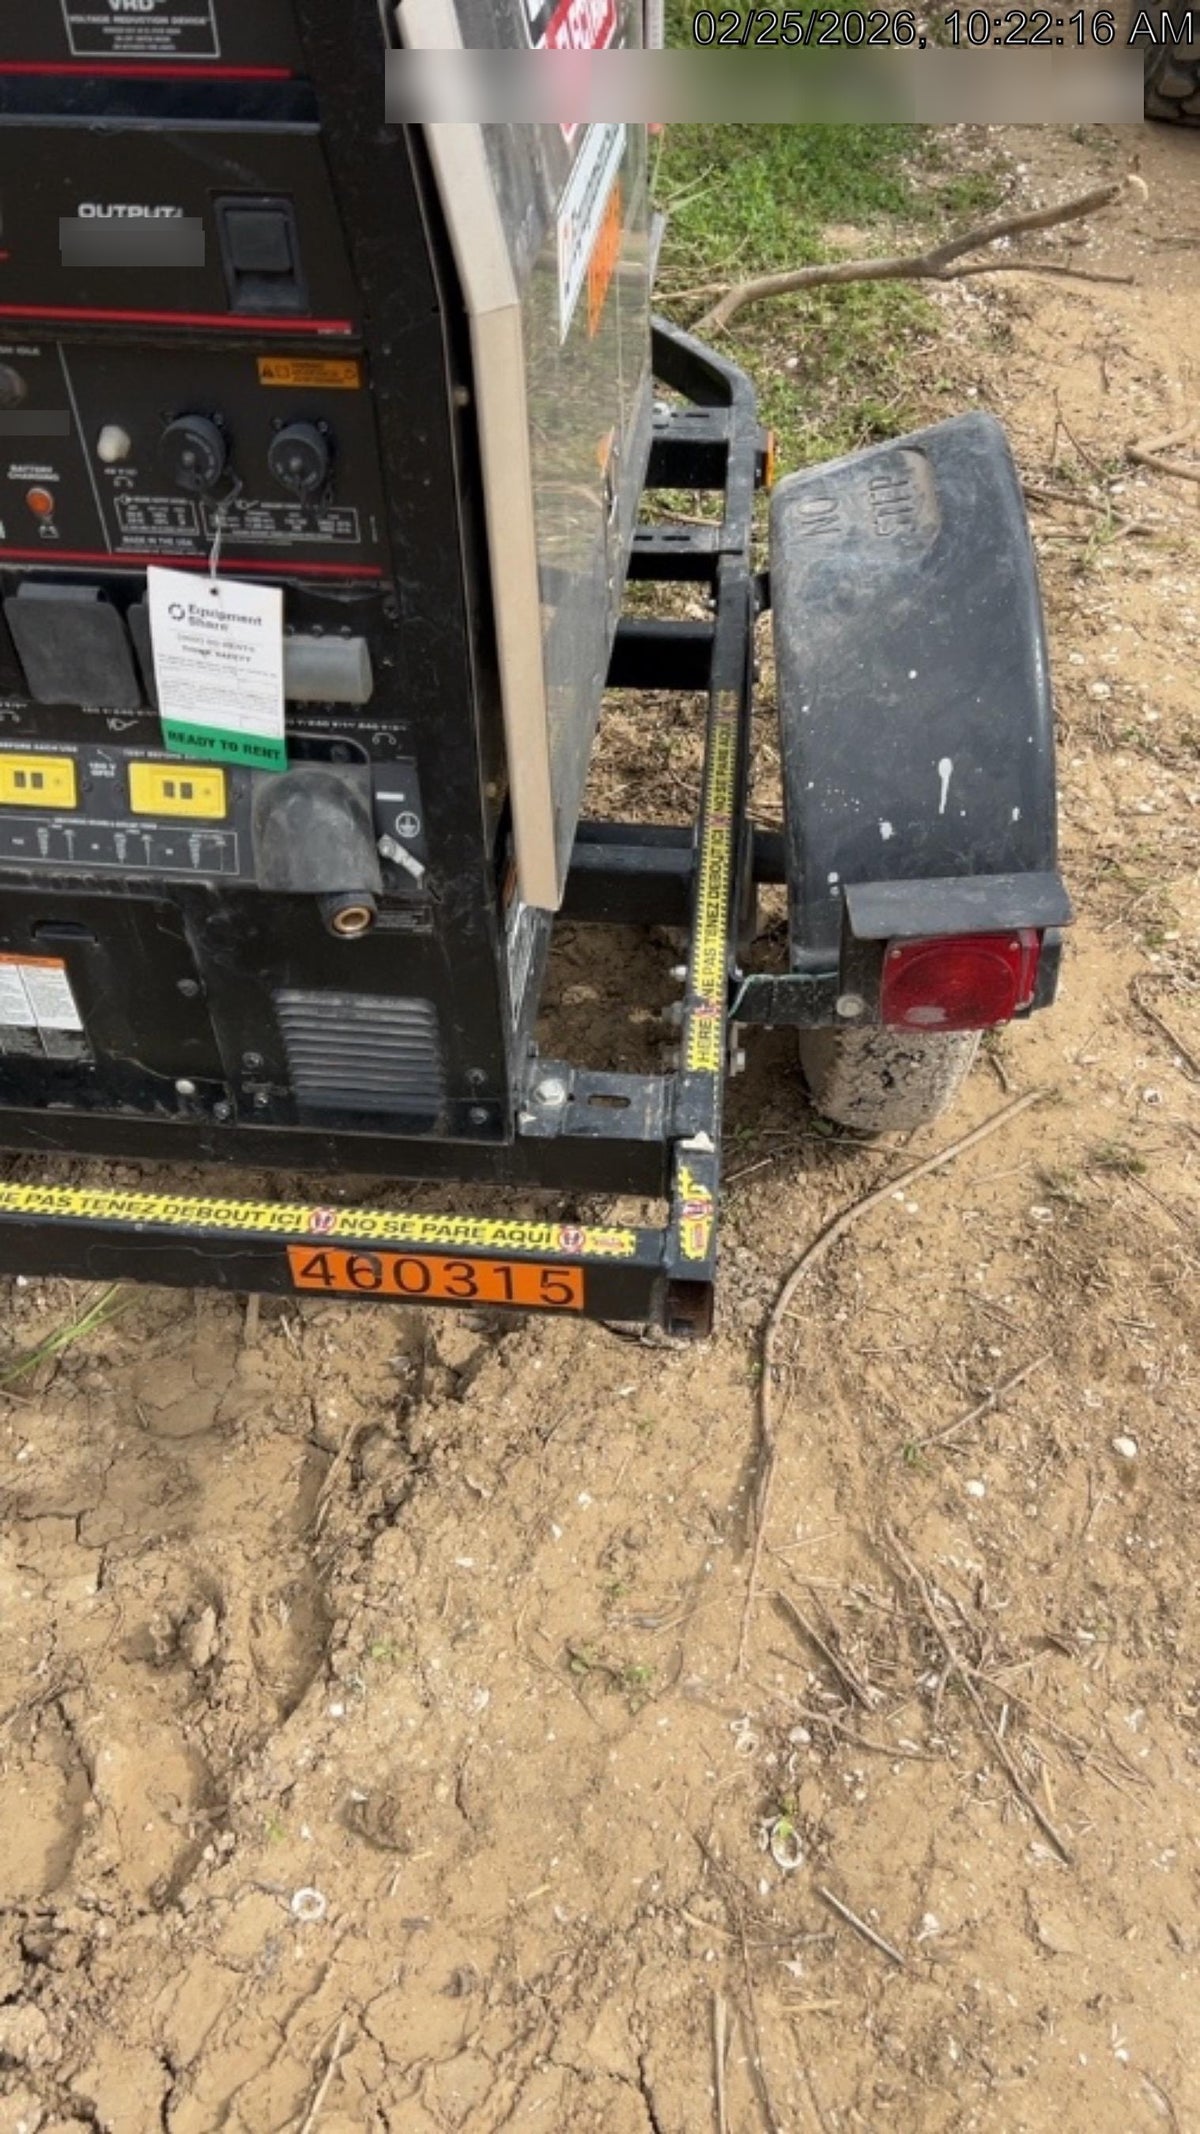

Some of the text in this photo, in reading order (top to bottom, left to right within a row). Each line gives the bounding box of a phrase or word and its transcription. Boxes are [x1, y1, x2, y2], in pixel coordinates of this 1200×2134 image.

[188, 603, 262, 626] Equipment
[188, 616, 229, 632] Share
[167, 730, 281, 760] READY TO RENT
[703, 948, 717, 974] PAS
[698, 1019, 713, 1064] HERE
[24, 1193, 72, 1208] PAS
[78, 1196, 157, 1215] TENEZ
[162, 1204, 266, 1222] DEBOUT
[269, 1212, 302, 1226] ICI
[340, 1217, 377, 1232] NO
[383, 1220, 415, 1235] SE
[421, 1223, 486, 1240] PARE
[491, 1228, 551, 1244] AQUI
[299, 1252, 575, 1306] 460315
